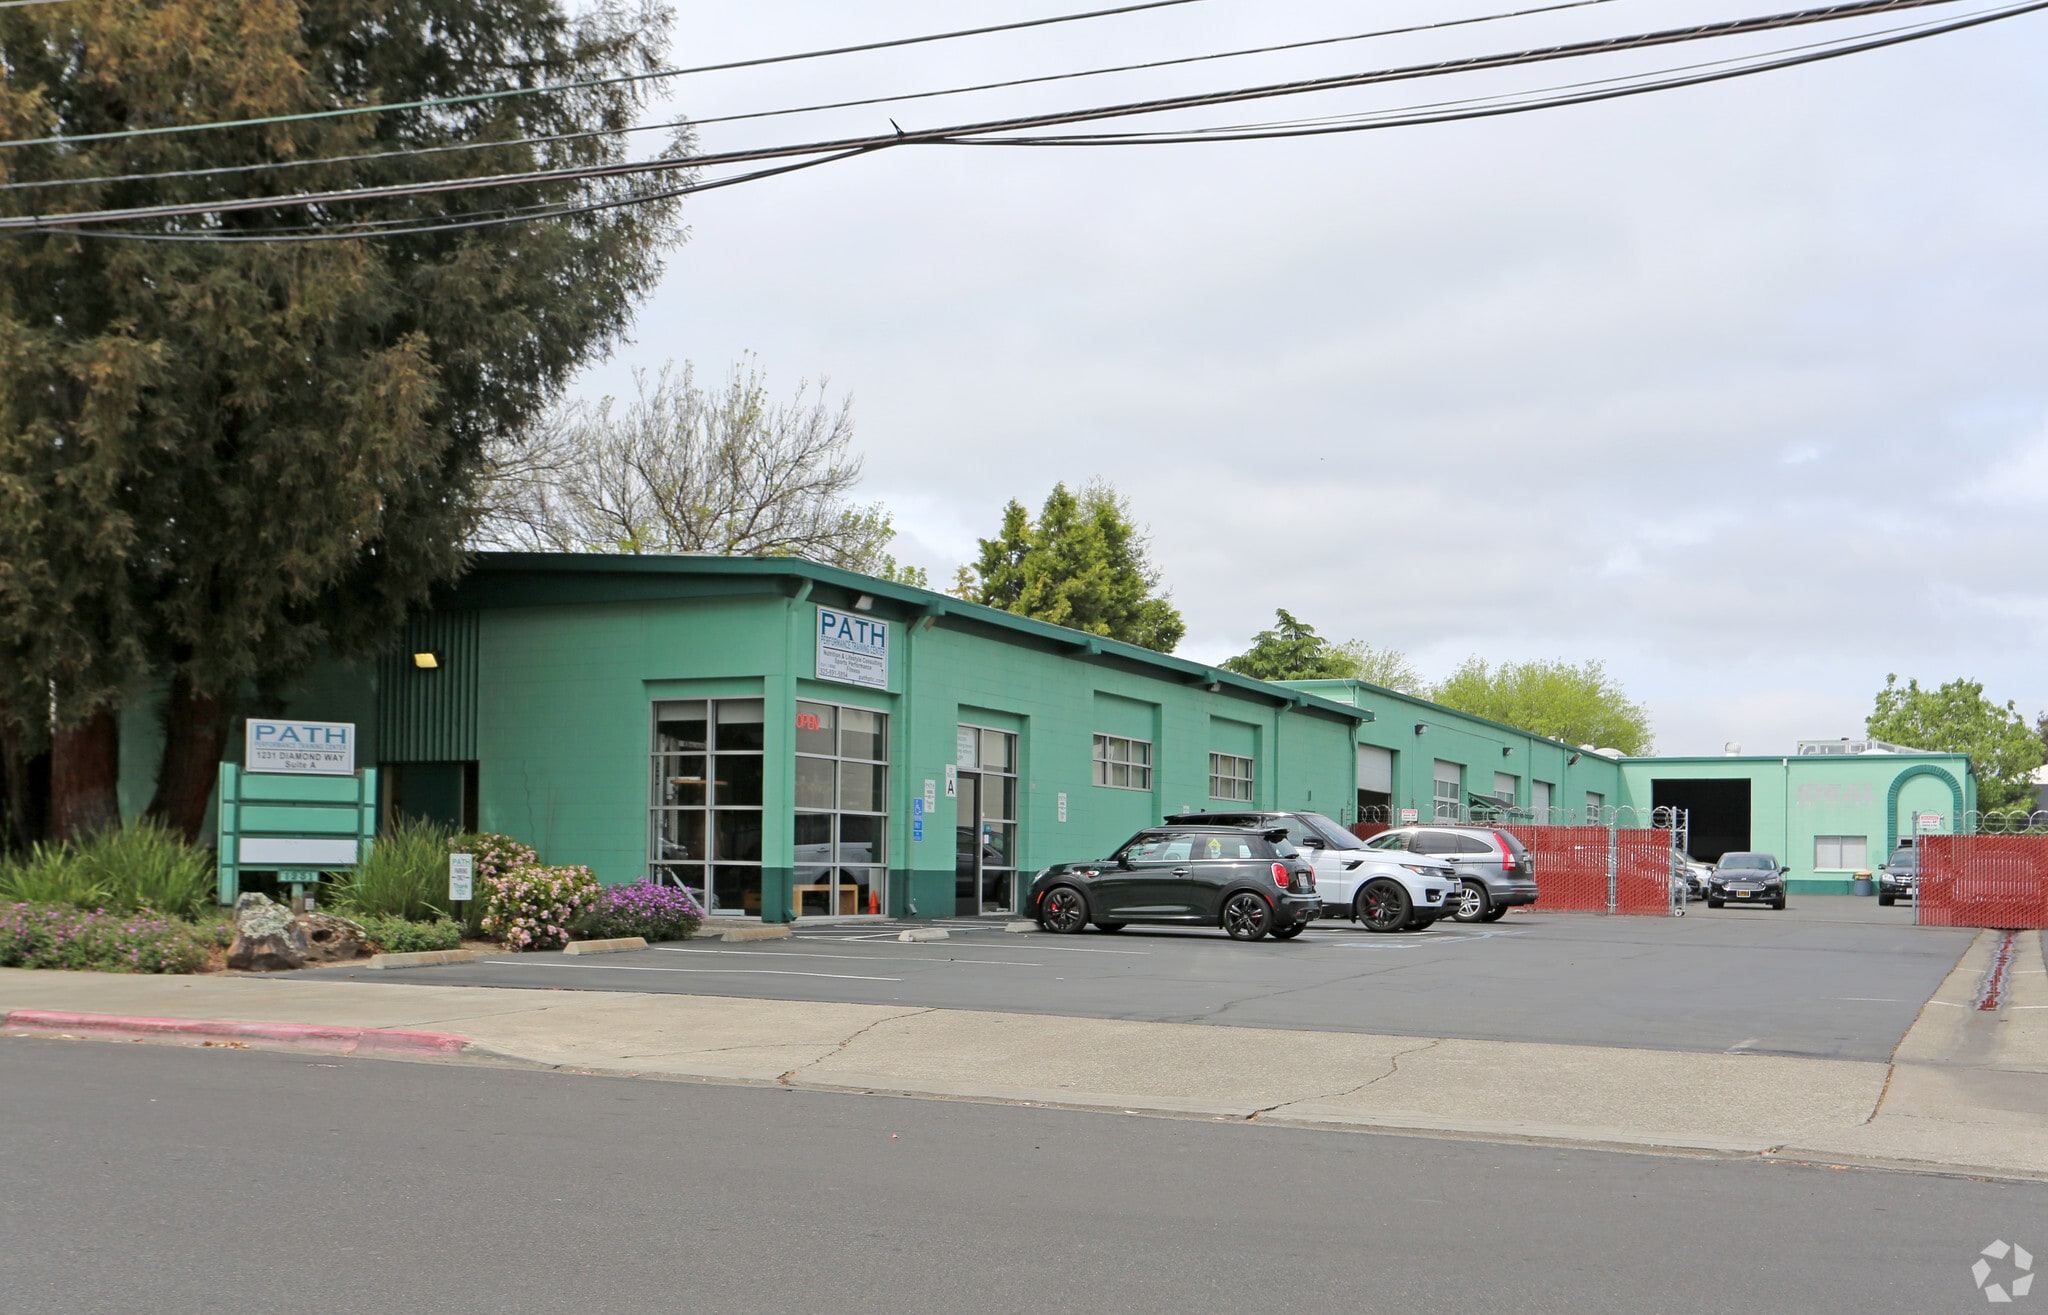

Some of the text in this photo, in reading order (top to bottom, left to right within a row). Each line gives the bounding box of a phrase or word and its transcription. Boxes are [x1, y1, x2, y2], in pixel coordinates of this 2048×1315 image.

[822, 612, 885, 647] PATH
[821, 635, 851, 650] PERFORMANCE
[795, 711, 820, 731] OPEN
[255, 725, 346, 744] PATH
[255, 741, 295, 749] PERFORMANCE
[257, 751, 344, 761] 1231 DIAMOND WAY
[947, 779, 955, 795] A
